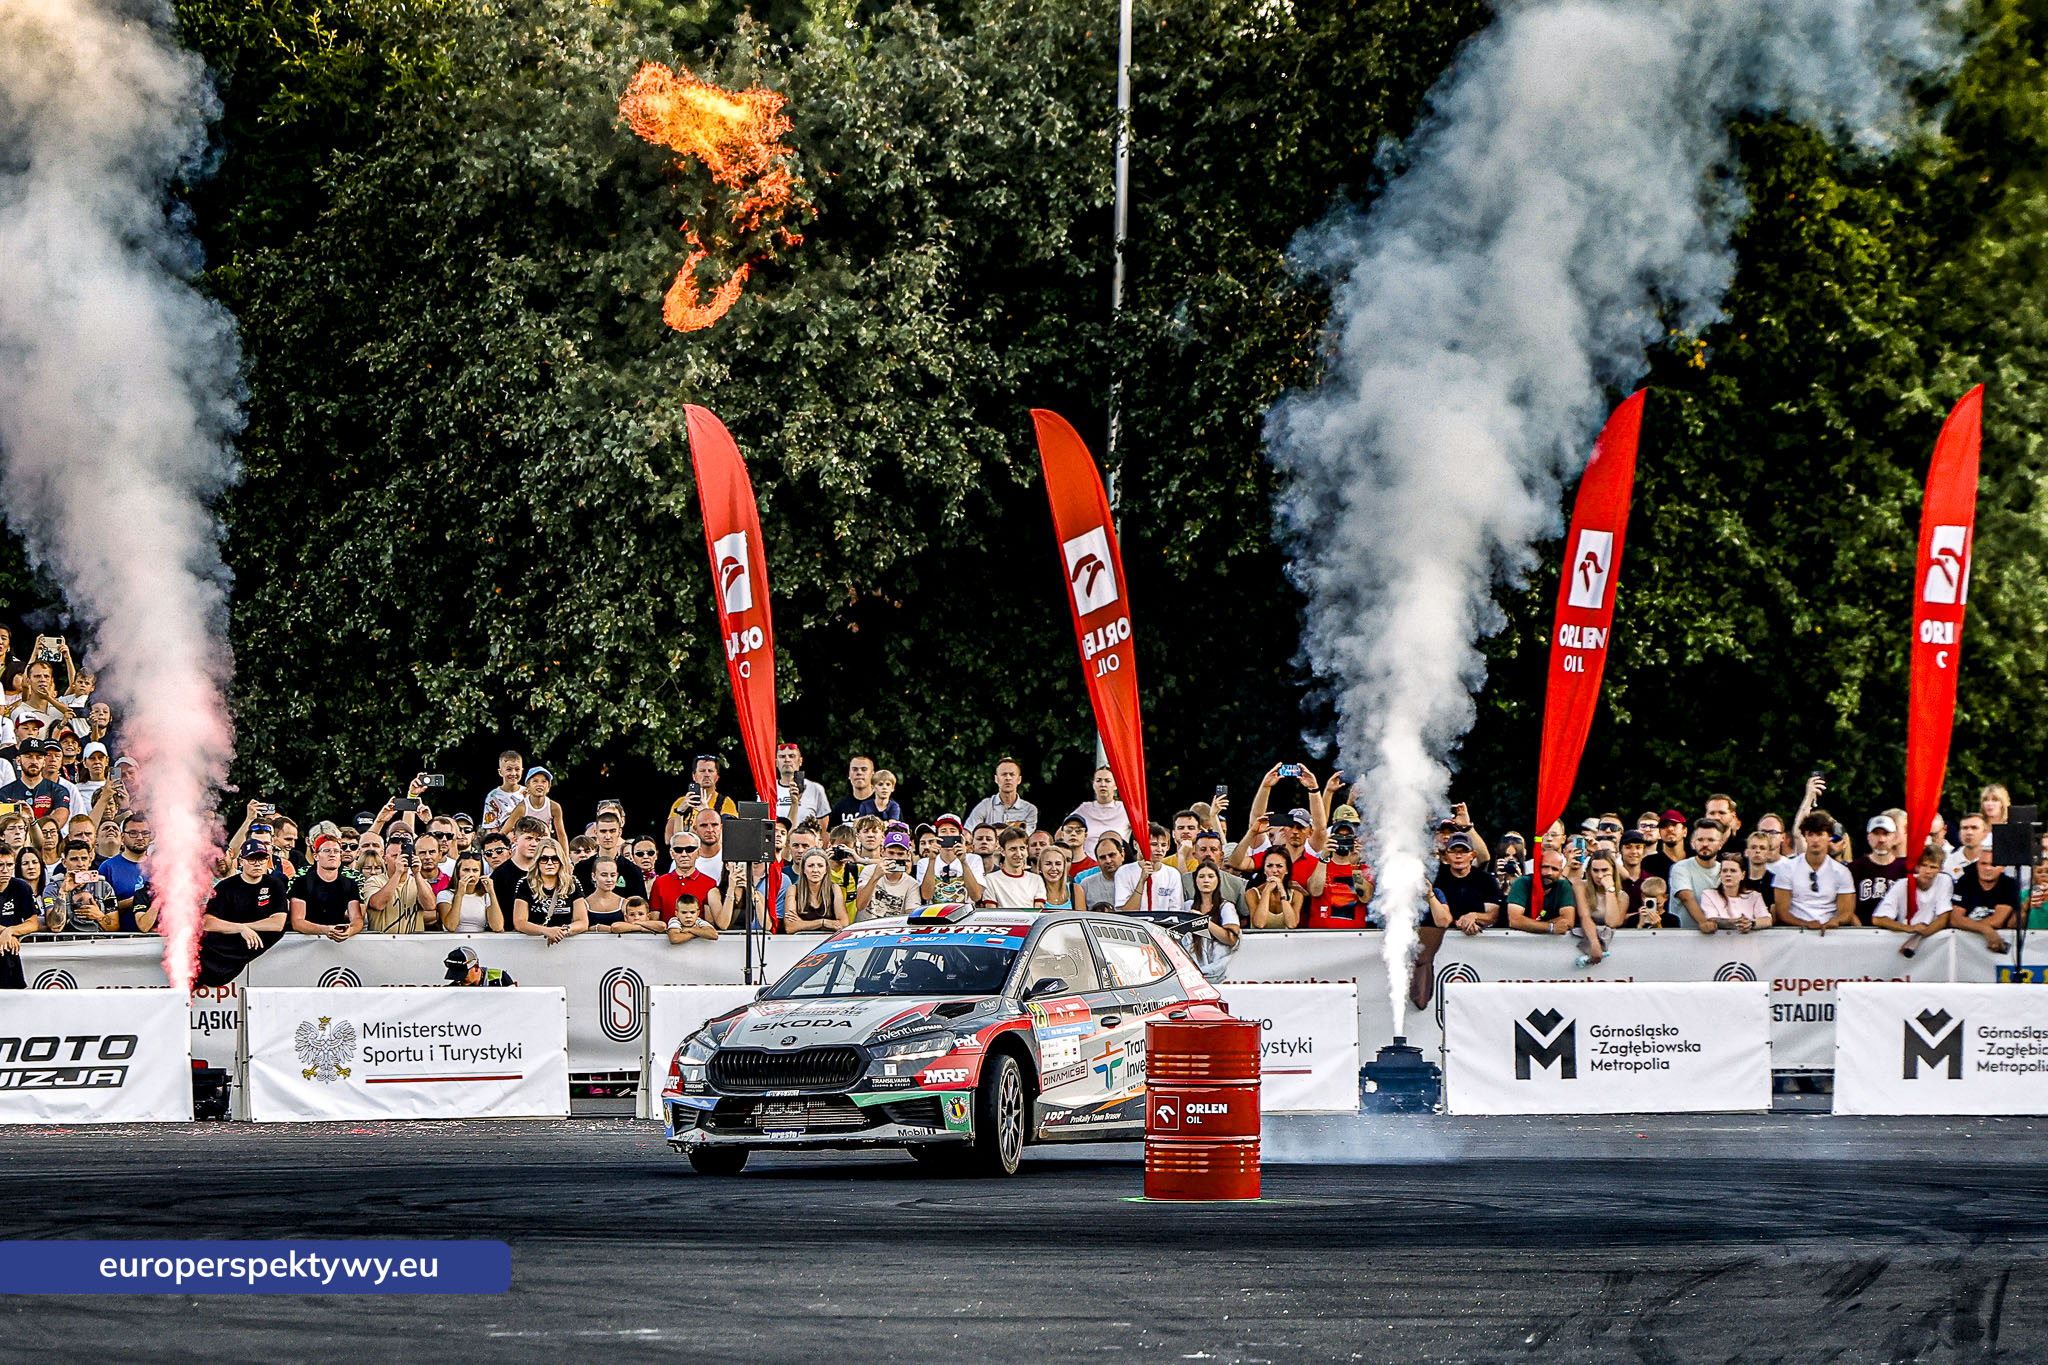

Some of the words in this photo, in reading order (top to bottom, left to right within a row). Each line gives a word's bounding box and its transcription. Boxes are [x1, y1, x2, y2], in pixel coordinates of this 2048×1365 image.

[1563, 654, 1585, 673] OIL
[848, 926, 921, 940] MRF
[927, 925, 1012, 936] TYRES
[796, 953, 829, 969] 23
[1141, 945, 1166, 977] 23
[1773, 1003, 1835, 1022] STADIO
[363, 1021, 482, 1039] Ministerstwo
[1590, 1023, 1679, 1040] Górnośląsko
[1978, 1025, 2048, 1042] Górnośląs
[363, 1045, 423, 1066] Sportu
[430, 1044, 434, 1061] i
[439, 1042, 522, 1064] Turystyki
[1124, 1037, 1146, 1057] Tran
[1591, 1040, 1702, 1057] -Zagłębiowska
[1126, 1058, 1146, 1078] Inve
[1591, 1057, 1671, 1074] Metropolia
[1978, 1058, 2048, 1076] Metropoli
[924, 1068, 969, 1084] MRF
[1043, 1065, 1086, 1086] DINAMIC92
[1185, 1103, 1228, 1114] ORLEN
[1186, 1115, 1203, 1124] OIL
[897, 1128, 926, 1137] Mobil
